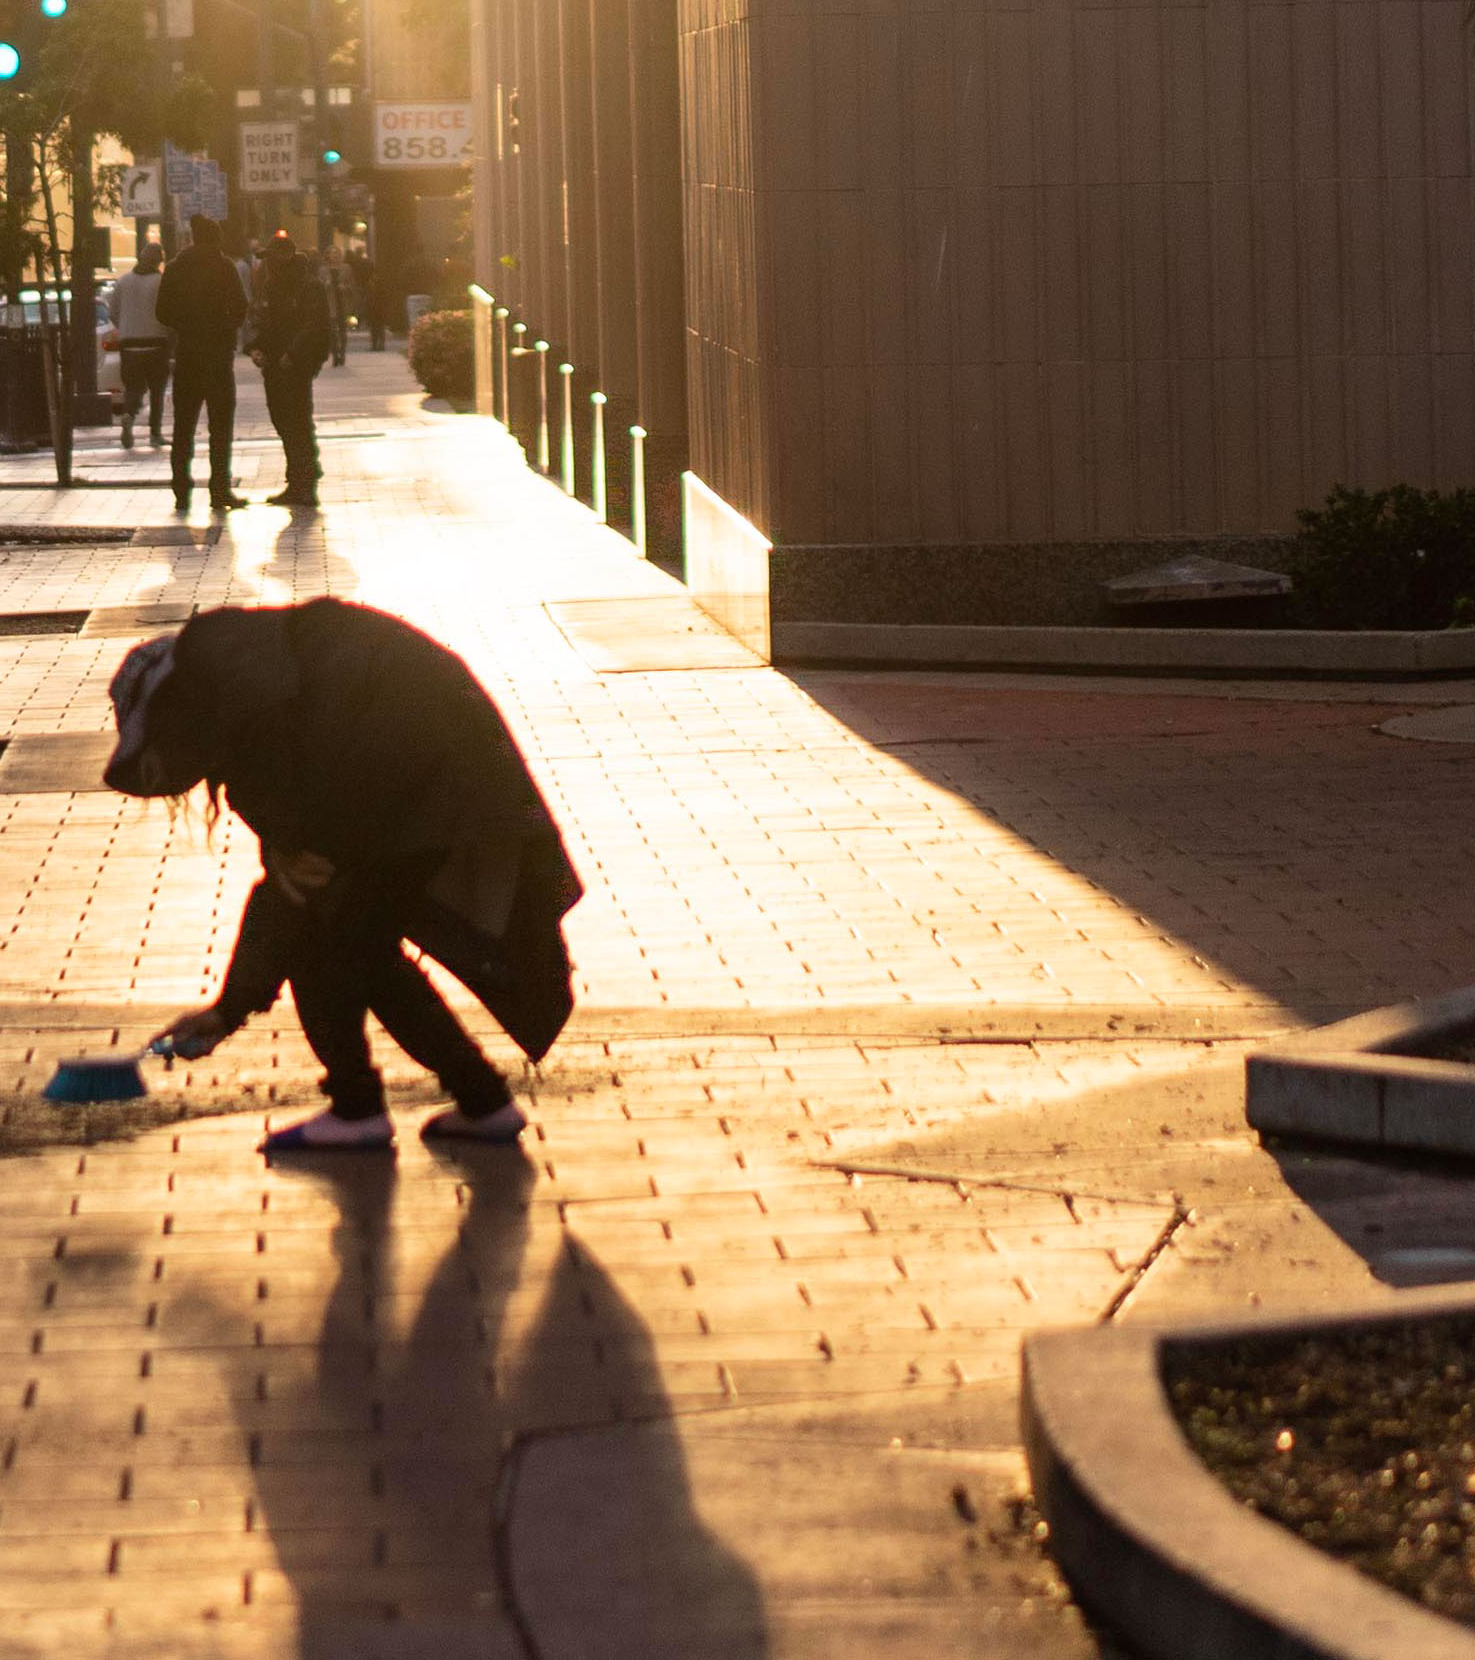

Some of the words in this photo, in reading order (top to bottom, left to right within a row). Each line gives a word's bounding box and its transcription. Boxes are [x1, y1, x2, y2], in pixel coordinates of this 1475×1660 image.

[382, 110, 464, 130] OFFICE
[247, 133, 293, 147] RIGHT
[248, 152, 291, 164] TURN
[249, 170, 291, 182] ONLY
